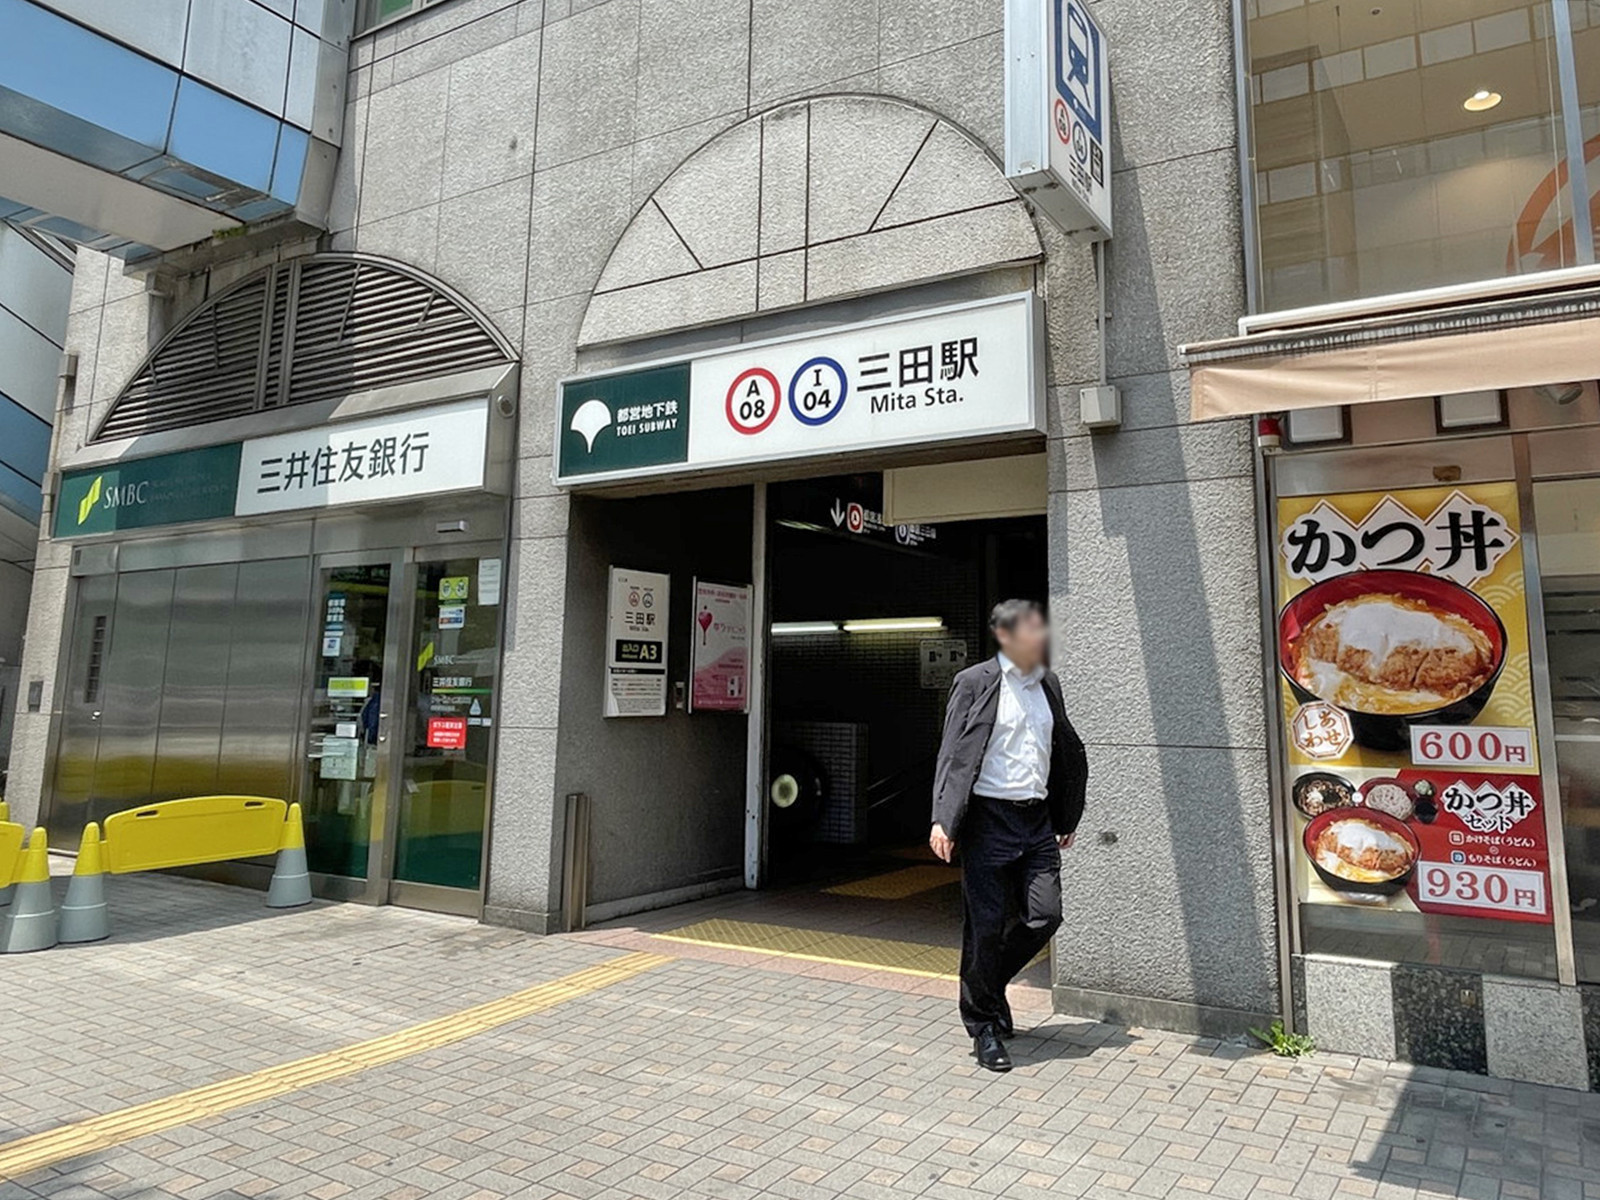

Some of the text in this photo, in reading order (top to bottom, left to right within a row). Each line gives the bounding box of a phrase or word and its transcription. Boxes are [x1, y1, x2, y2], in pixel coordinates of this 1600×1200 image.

[856, 336, 980, 393] 三田駅
[746, 379, 761, 398] A
[812, 368, 823, 387] I
[616, 400, 679, 423] 都営地下鉄
[739, 398, 766, 421] 08
[802, 388, 832, 412] 04
[869, 387, 964, 415] Mita Sta.
[616, 418, 678, 437] TOEI SUBWAY
[257, 431, 430, 494] 三井住友銀行
[103, 481, 149, 509] SMBC
[1286, 510, 1506, 575] かつ丼
[624, 611, 656, 626] 三田駅
[639, 644, 658, 660] A3
[1419, 731, 1527, 763] 600円
[1444, 787, 1532, 817] かつ丼
[1465, 813, 1511, 832] セット
[1426, 867, 1537, 907] 930円
